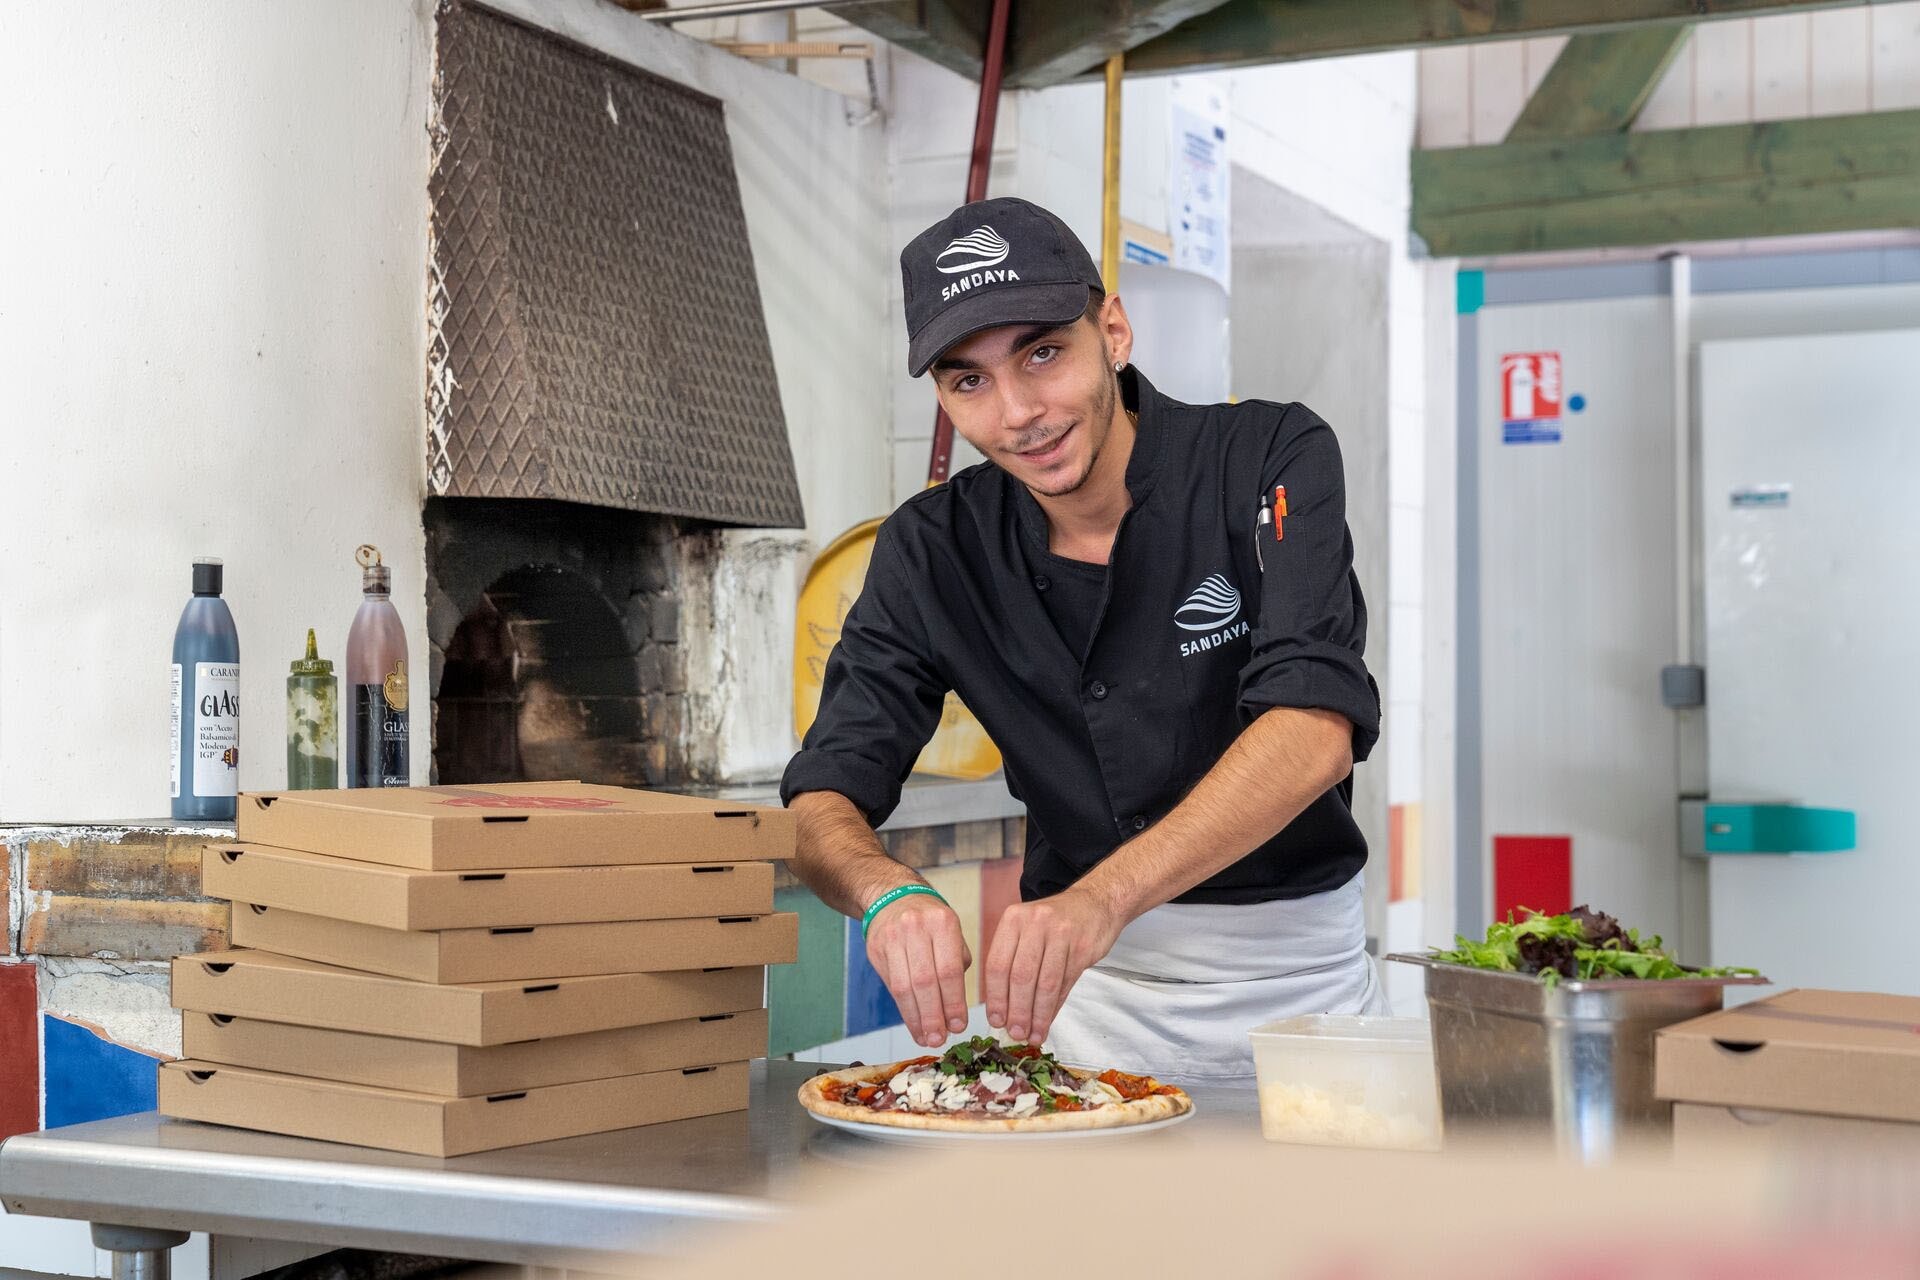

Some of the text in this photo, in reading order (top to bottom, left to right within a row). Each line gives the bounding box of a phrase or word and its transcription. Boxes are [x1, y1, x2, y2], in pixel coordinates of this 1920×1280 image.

[941, 269, 1020, 301] SANDAYA
[1180, 621, 1250, 657] SANDAYA
[200, 742, 227, 750] Modena
[868, 889, 902, 914] SANDAYA
